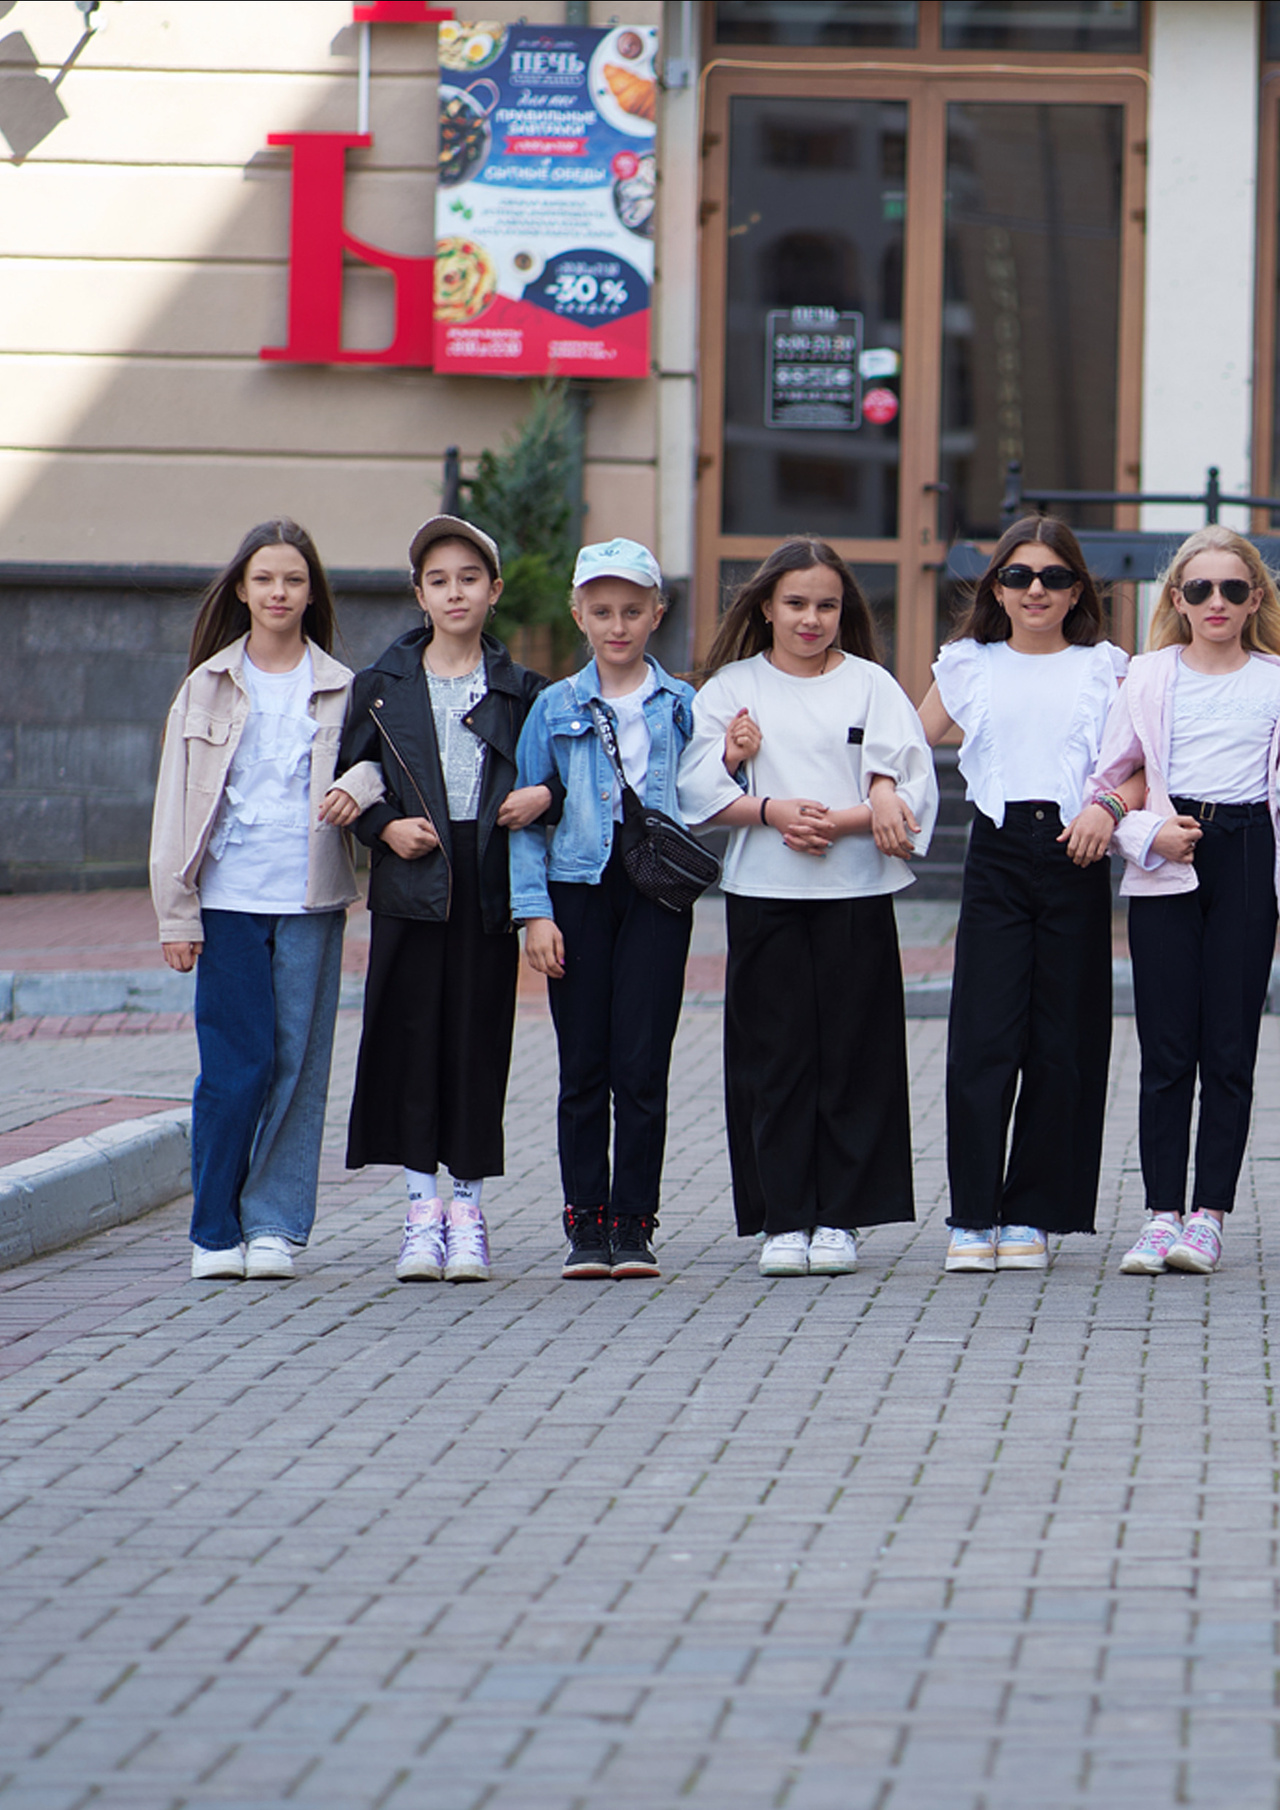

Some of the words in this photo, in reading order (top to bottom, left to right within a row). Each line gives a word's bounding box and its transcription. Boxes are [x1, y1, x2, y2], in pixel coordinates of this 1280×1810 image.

[510, 51, 586, 75] ПЕЧЬ
[484, 165, 549, 181] СЫТНЫЕ
[550, 167, 607, 184] ОБЕДЫ
